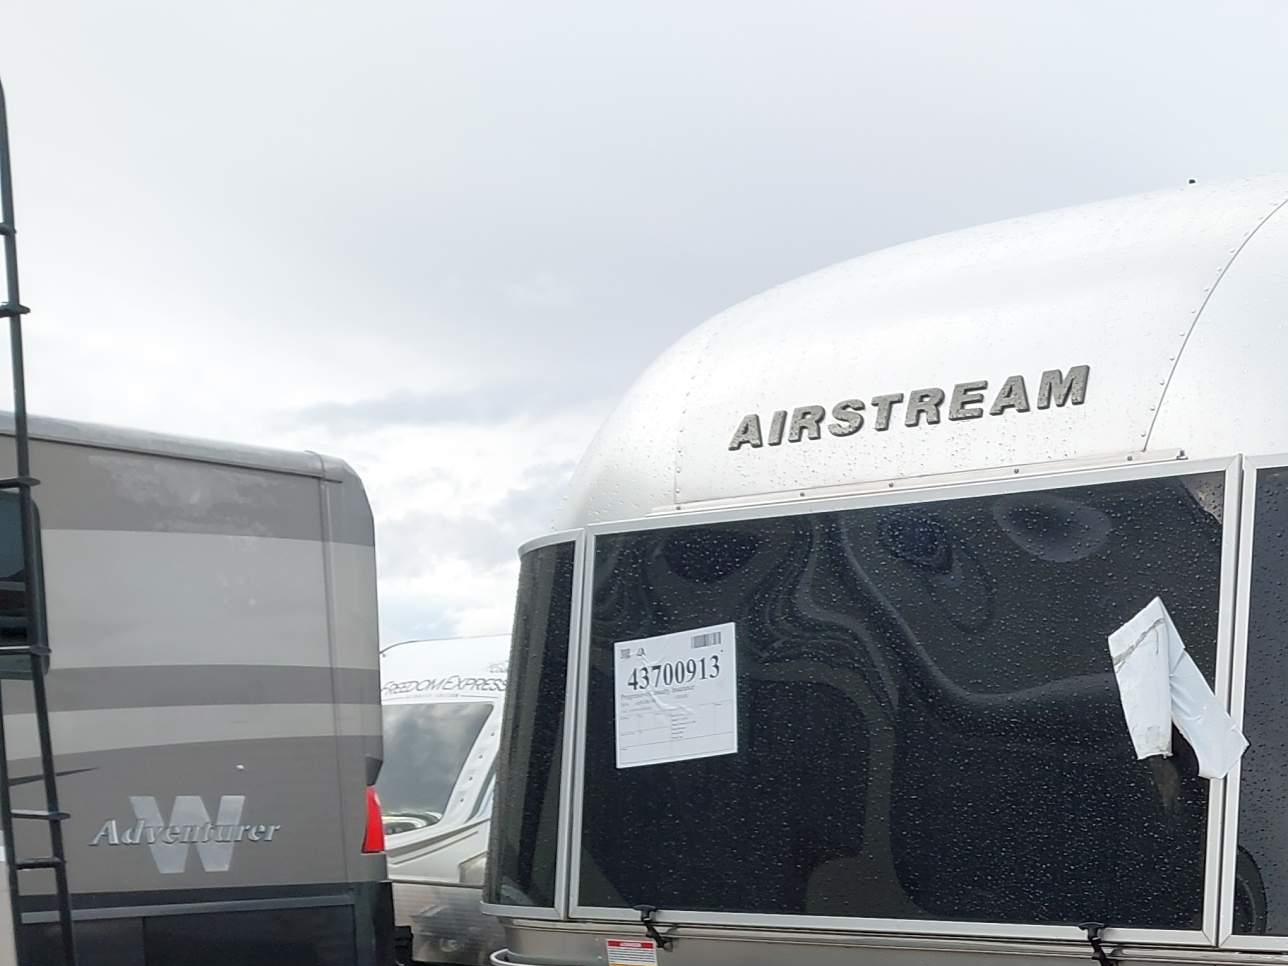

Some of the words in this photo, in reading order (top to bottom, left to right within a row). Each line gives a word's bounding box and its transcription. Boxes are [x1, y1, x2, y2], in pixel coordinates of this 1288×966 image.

[728, 364, 1090, 451] AIRSTREAM
[627, 655, 720, 691] 43700913
[88, 819, 281, 847] Adventurer
